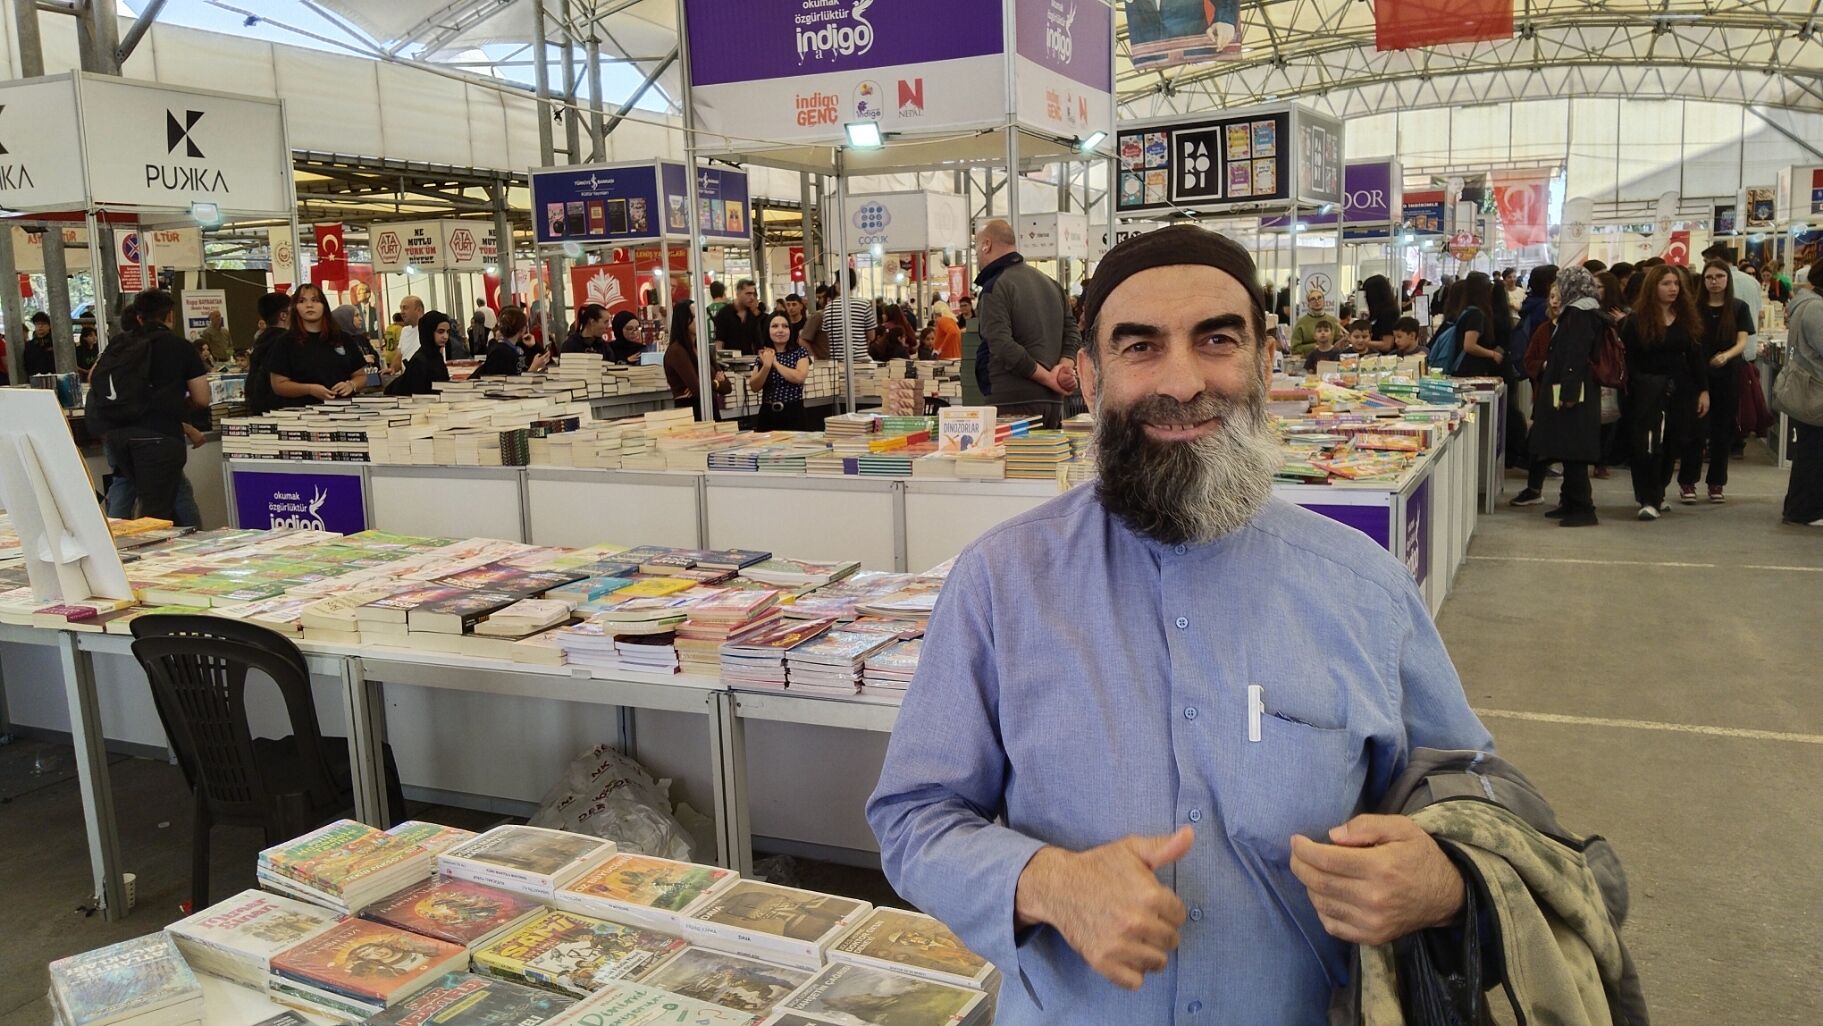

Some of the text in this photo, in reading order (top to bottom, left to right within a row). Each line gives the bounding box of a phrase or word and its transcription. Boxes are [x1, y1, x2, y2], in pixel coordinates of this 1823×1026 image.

[795, 9, 849, 24] özgürlüktür
[796, 23, 872, 56] indigo
[796, 92, 839, 109] indigo
[797, 106, 839, 126] GENÇ
[145, 164, 229, 193] PUKKA
[414, 228, 424, 237] NE
[455, 232, 470, 241] ATA
[380, 235, 396, 245] ATA
[408, 237, 431, 246] MUTLU
[482, 238, 497, 246] MUT
[380, 244, 398, 255] YURT
[453, 240, 473, 252] YURT
[479, 246, 497, 255] TÜRK
[483, 255, 498, 264] DİYE
[273, 491, 301, 500] okumak
[268, 501, 308, 513] özgürlüktür
